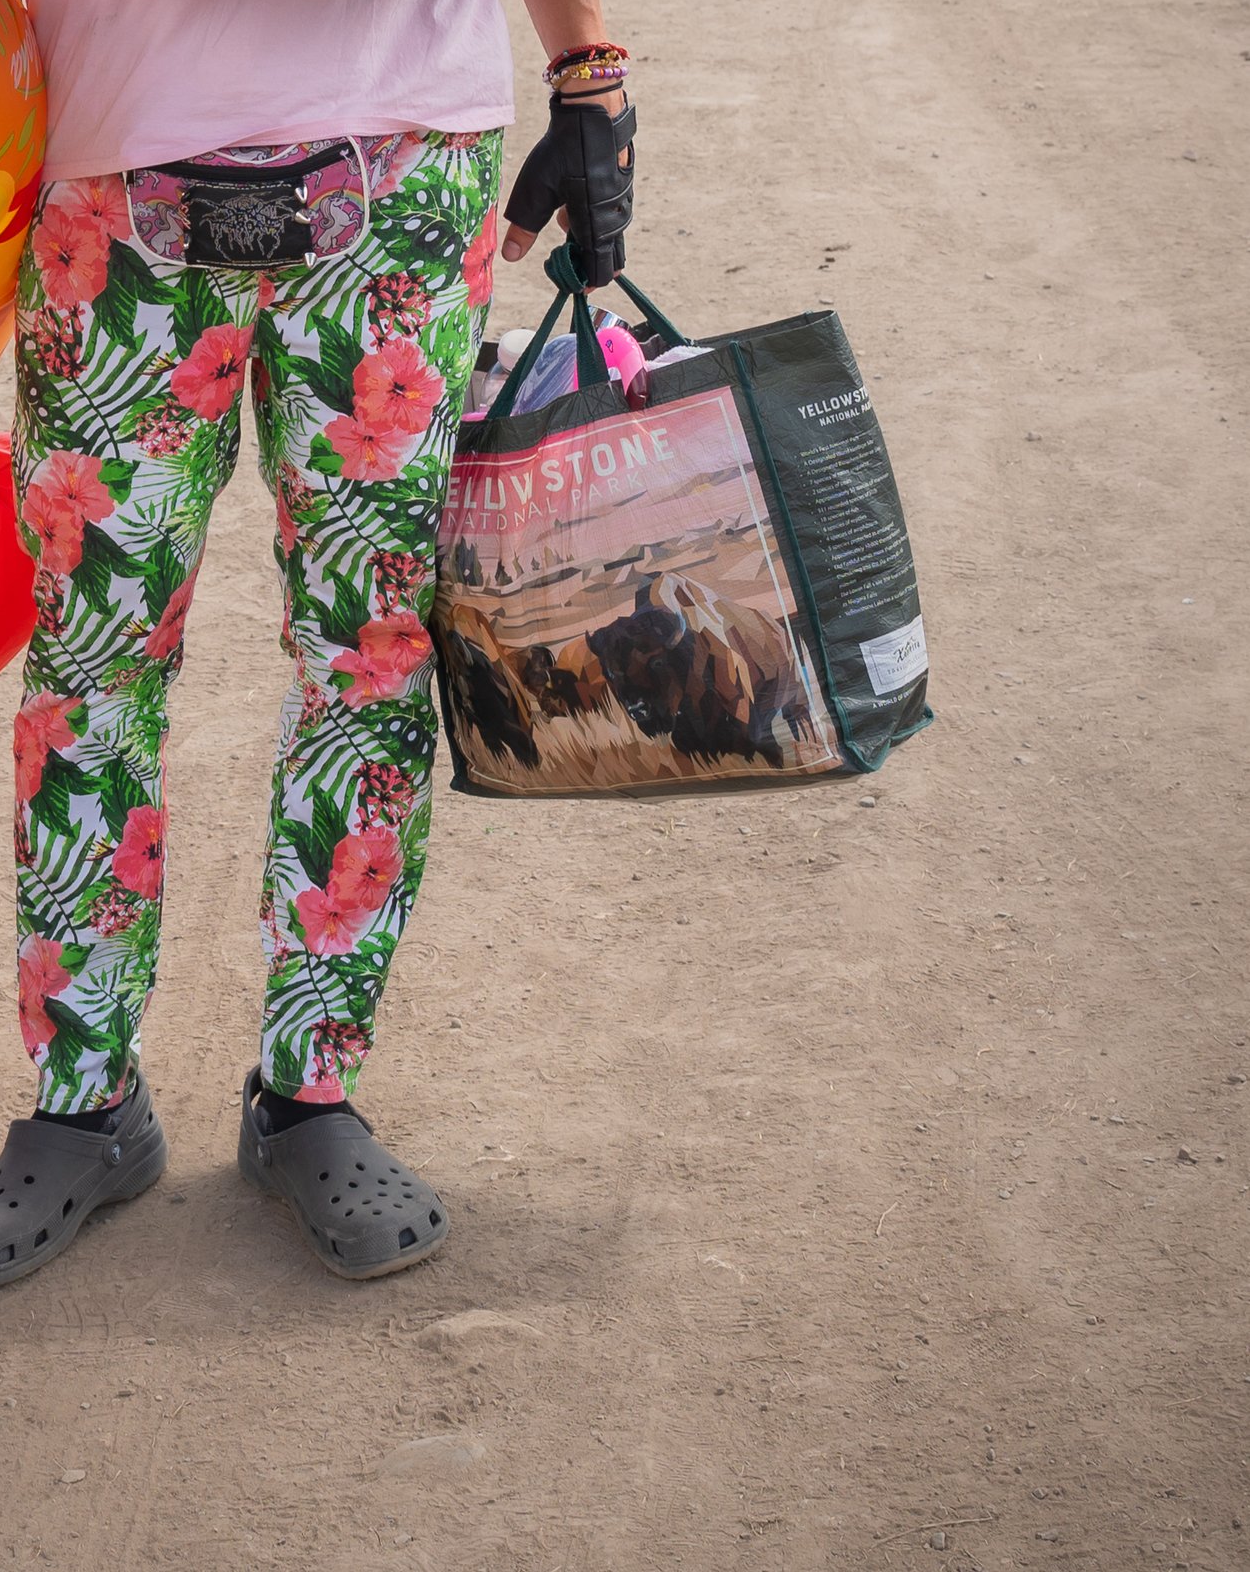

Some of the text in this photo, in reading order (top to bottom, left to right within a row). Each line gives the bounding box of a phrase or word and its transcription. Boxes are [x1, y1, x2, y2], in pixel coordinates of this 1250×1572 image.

[798, 386, 868, 419] YELLOWST
[819, 407, 860, 427] NATIONAL
[444, 428, 674, 510] ELLOWSTONE
[571, 470, 644, 506] PARK
